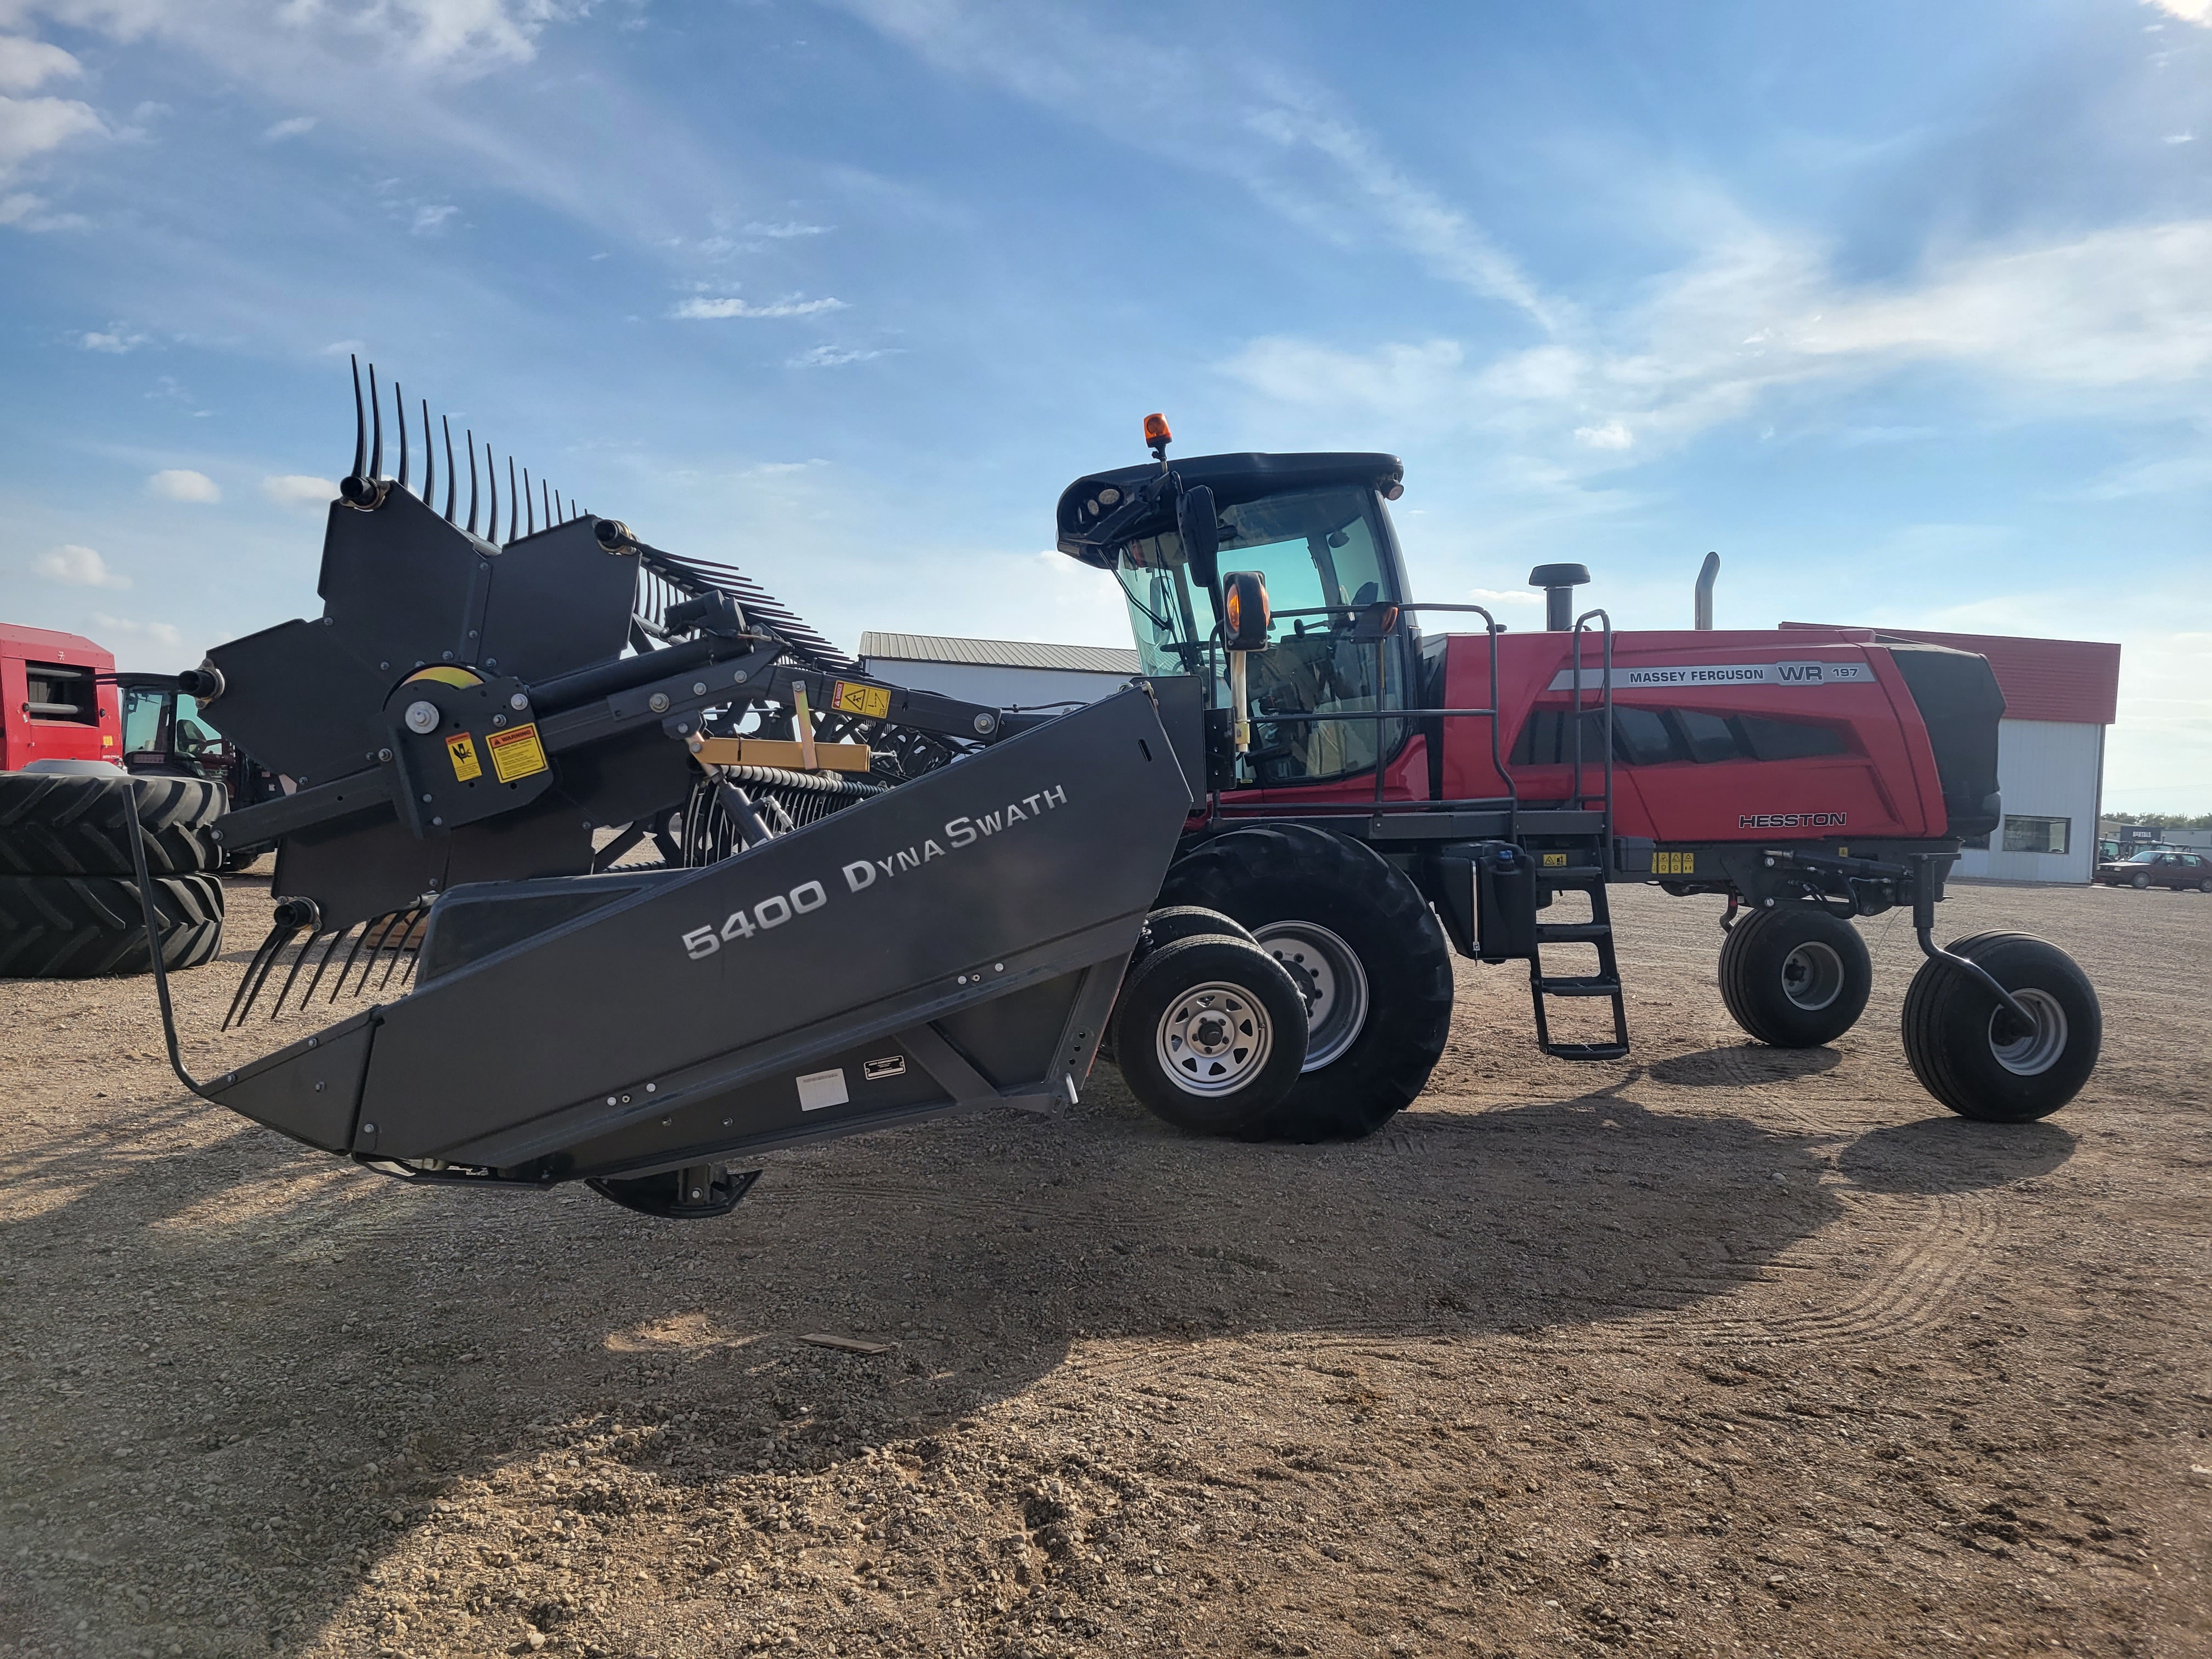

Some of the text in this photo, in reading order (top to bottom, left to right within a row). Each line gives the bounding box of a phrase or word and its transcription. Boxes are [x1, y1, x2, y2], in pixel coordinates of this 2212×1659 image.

[1630, 665, 1859, 684] MASSEY FERGUSON WR 197
[501, 730, 531, 742] WARNING
[1739, 812, 1847, 828] HESSTON
[681, 880, 827, 960] 5400
